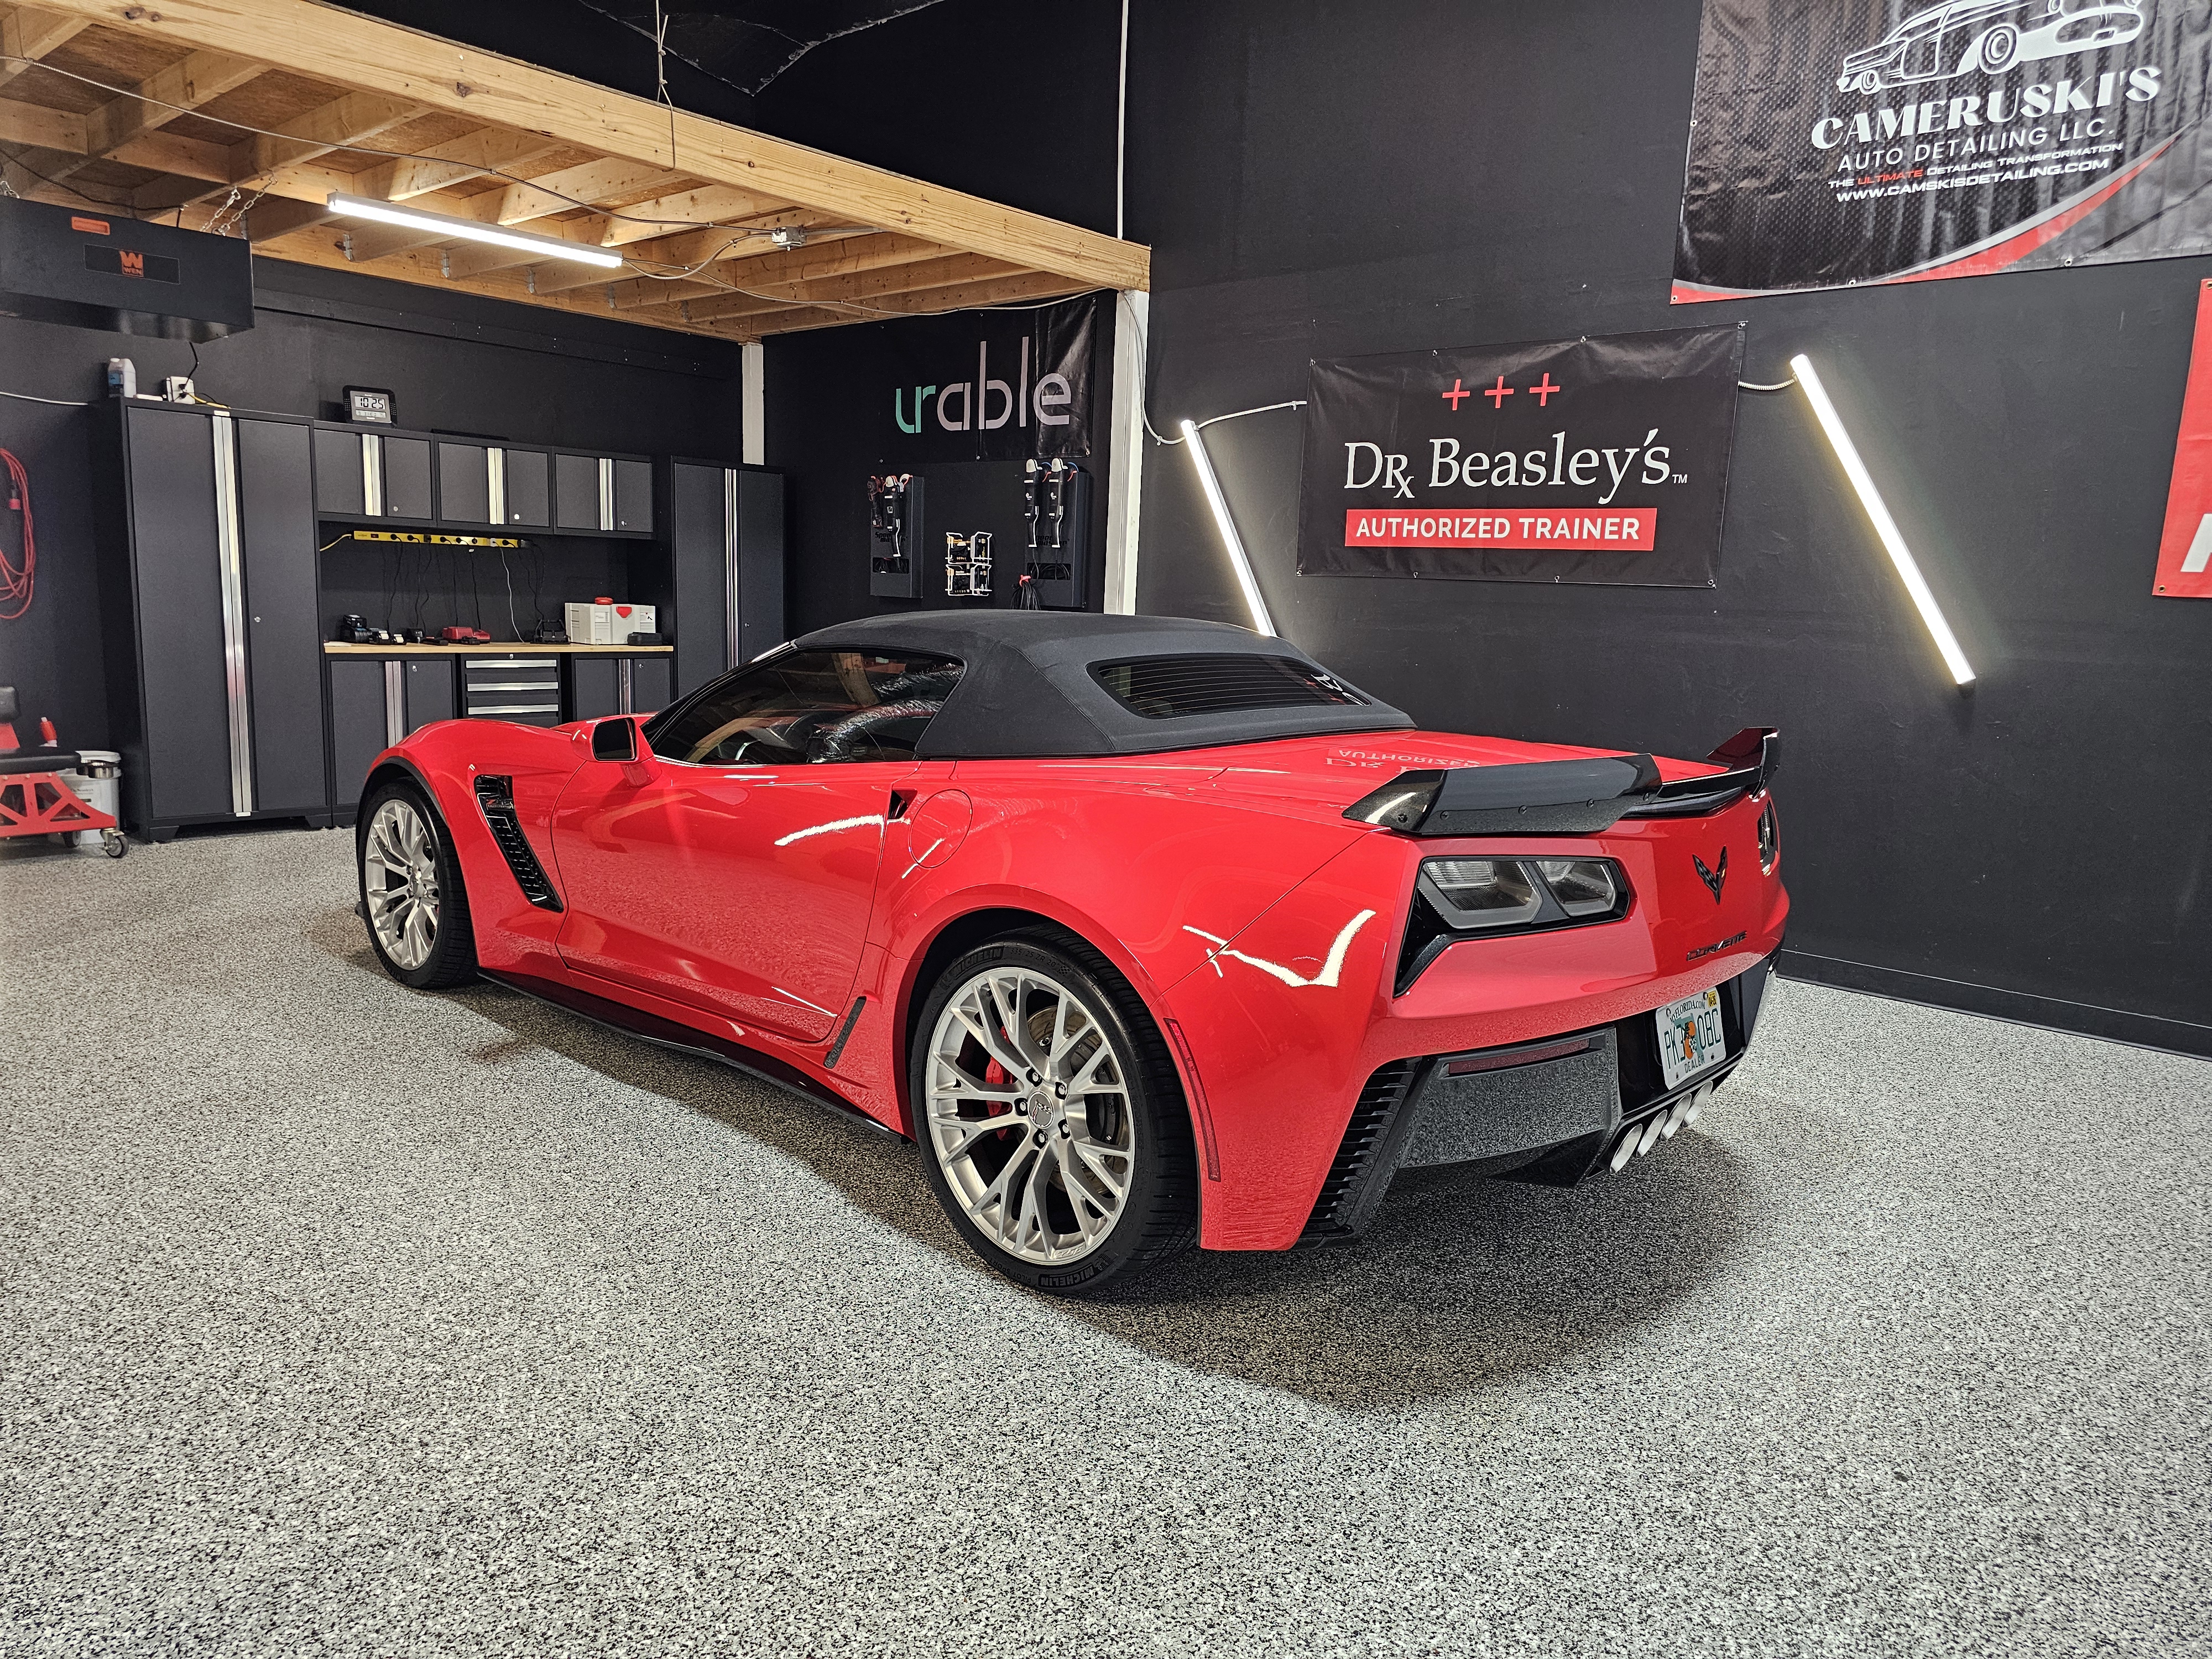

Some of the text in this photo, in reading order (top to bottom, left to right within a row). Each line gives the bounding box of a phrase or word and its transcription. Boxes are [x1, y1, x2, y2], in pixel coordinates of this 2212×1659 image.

[1811, 66, 2162, 149] CAMERUSKI'S
[1837, 118, 2115, 173] AUTO DETAILING LLC.
[1828, 142, 2124, 189] THE ULTIMATE DETAILING TRANSFORMATION
[1836, 158, 2110, 202] WWW.CAMSKISDETAILING.COM
[895, 336, 1071, 434] urable
[1428, 428, 1671, 505] Beasley's
[1356, 518, 1640, 540] AUTHORIZED TRAINER
[1010, 948, 1034, 958] 335/25
[1035, 953, 1046, 962] ZR
[1669, 1000, 1705, 1025] MYFLORIDA.COM
[1684, 1055, 1705, 1073] DEALER
[951, 1217, 974, 1245] SEASON
[975, 1245, 988, 1257] ALL
[988, 1258, 1011, 1274] SPORT
[1013, 1271, 1031, 1284] PILOT
[1040, 1265, 1095, 1287] MICHELIN
